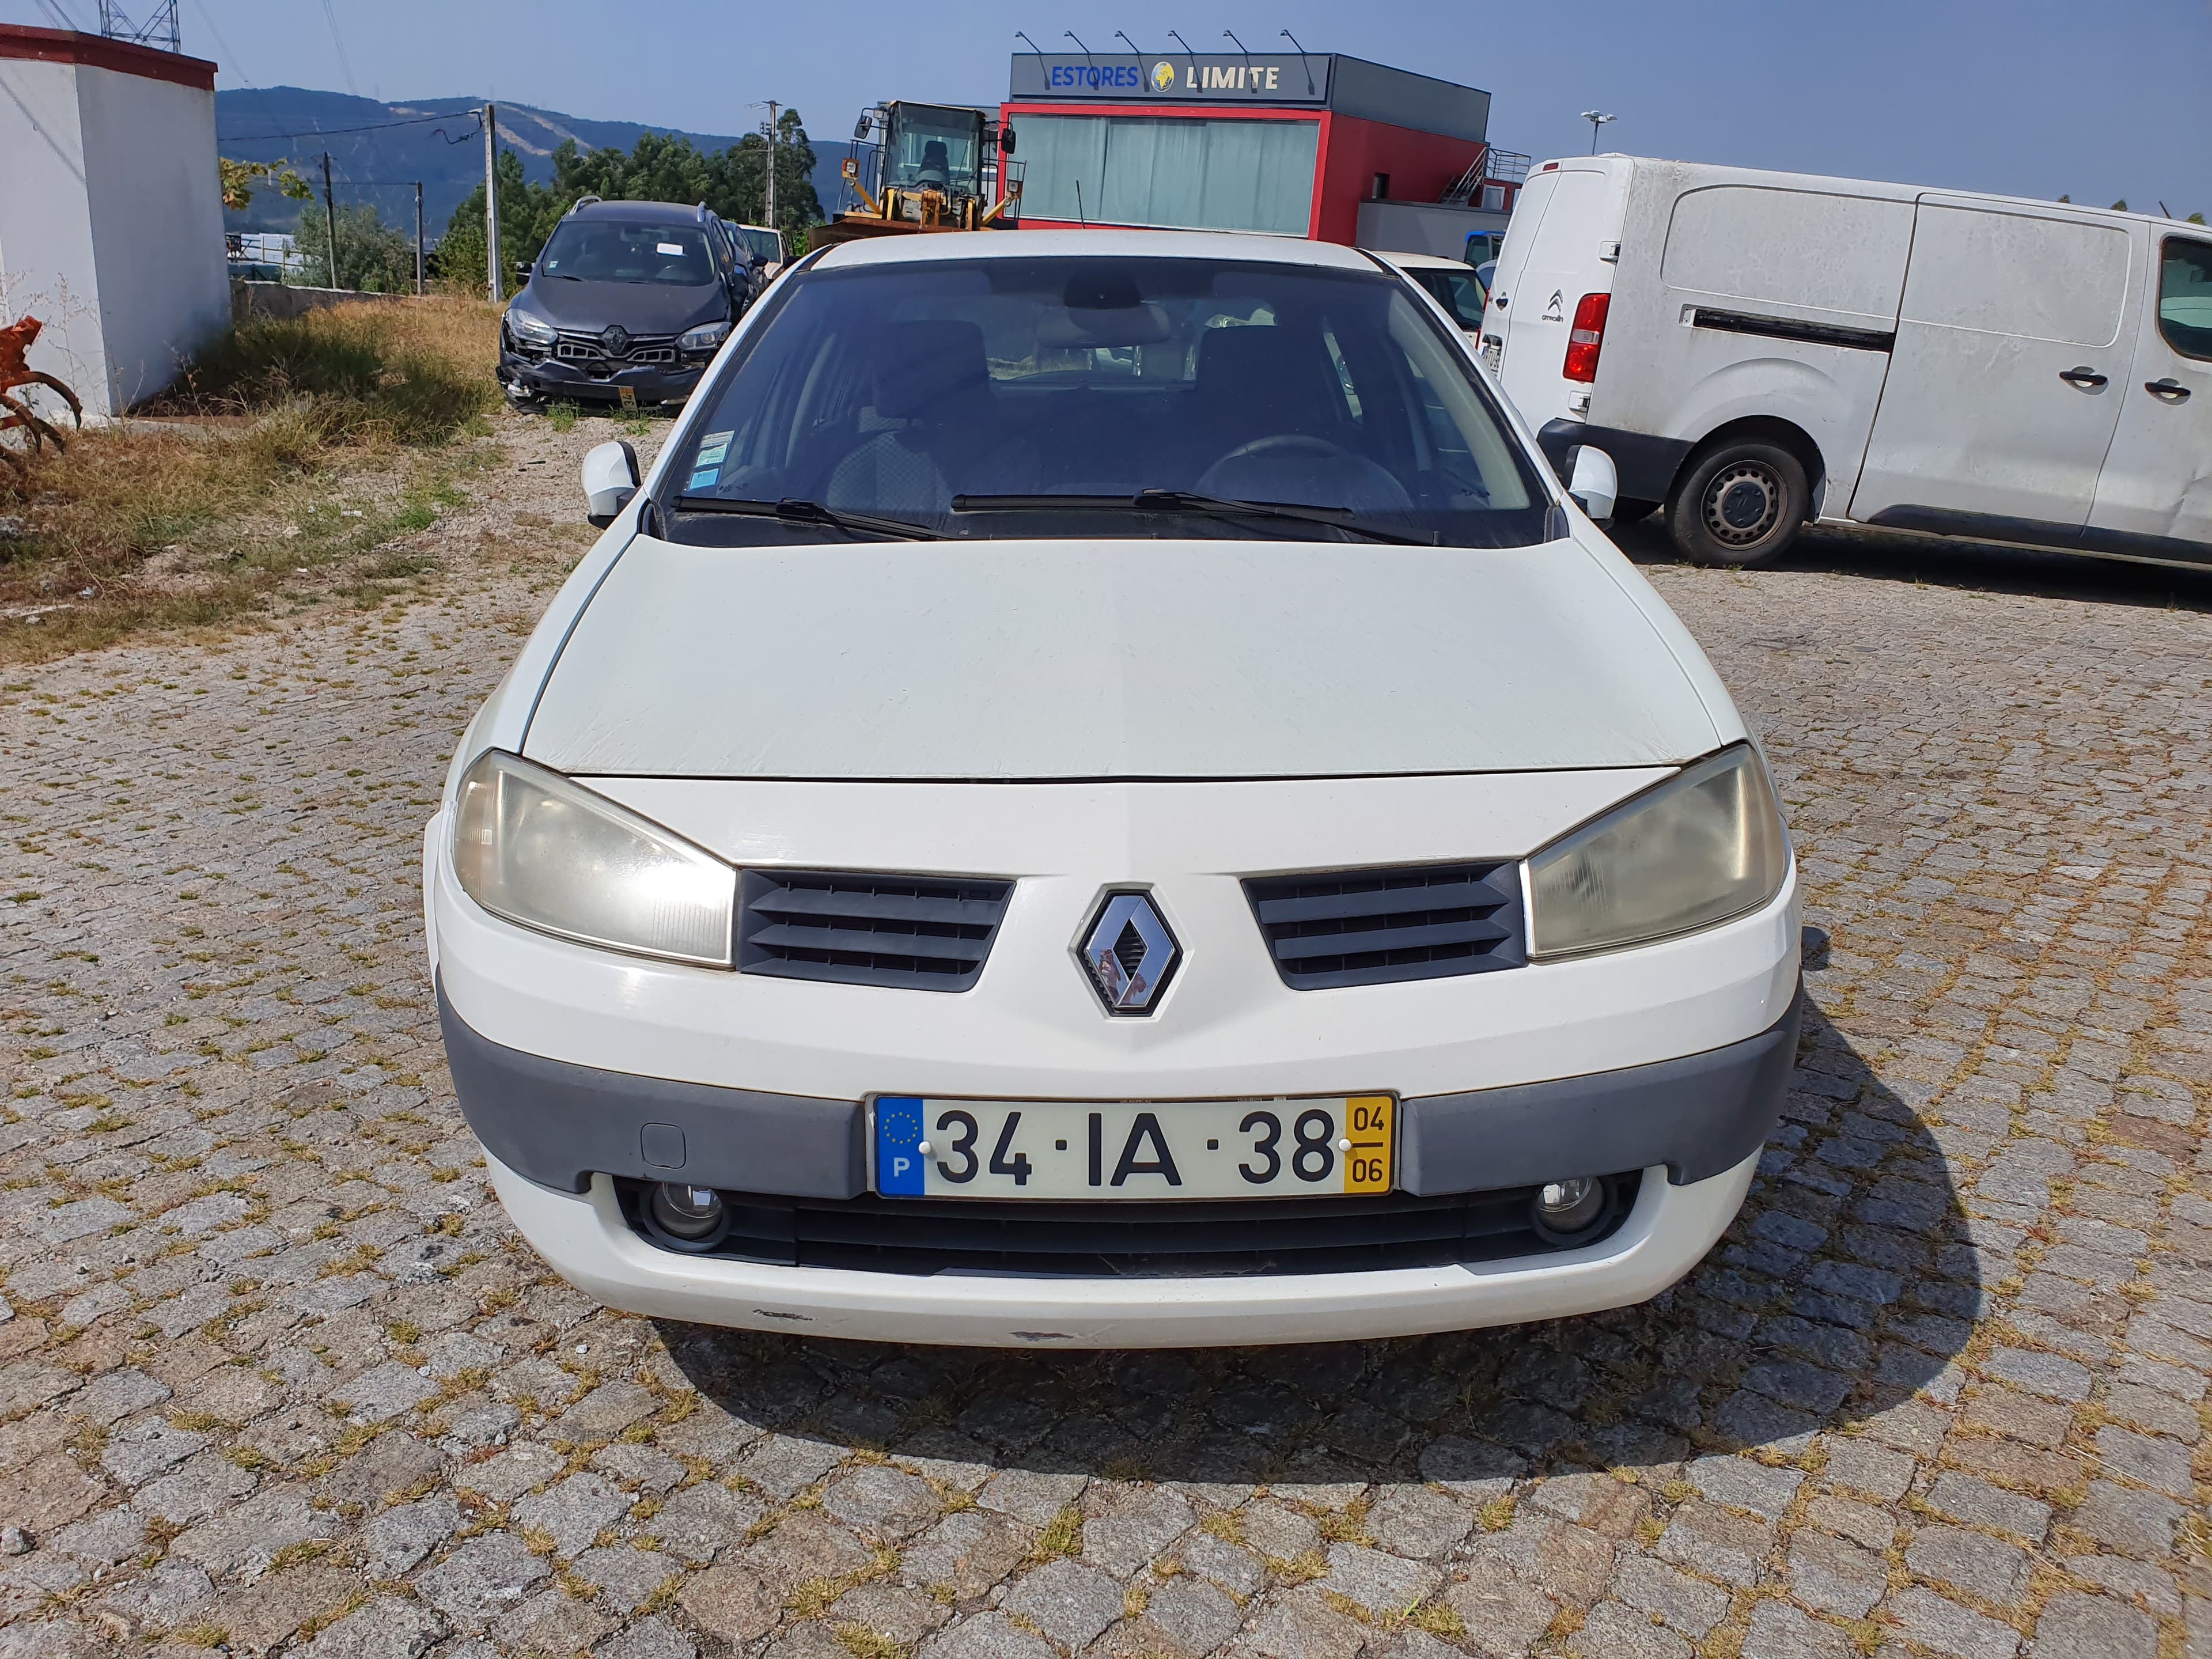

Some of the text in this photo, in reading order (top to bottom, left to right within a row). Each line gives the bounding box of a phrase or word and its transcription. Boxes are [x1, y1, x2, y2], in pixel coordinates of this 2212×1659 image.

[1052, 66, 1279, 89] ESTORES LIMITE
[1354, 1107, 1384, 1131] 04
[893, 1157, 910, 1177] P
[1352, 1158, 1383, 1183] 06
